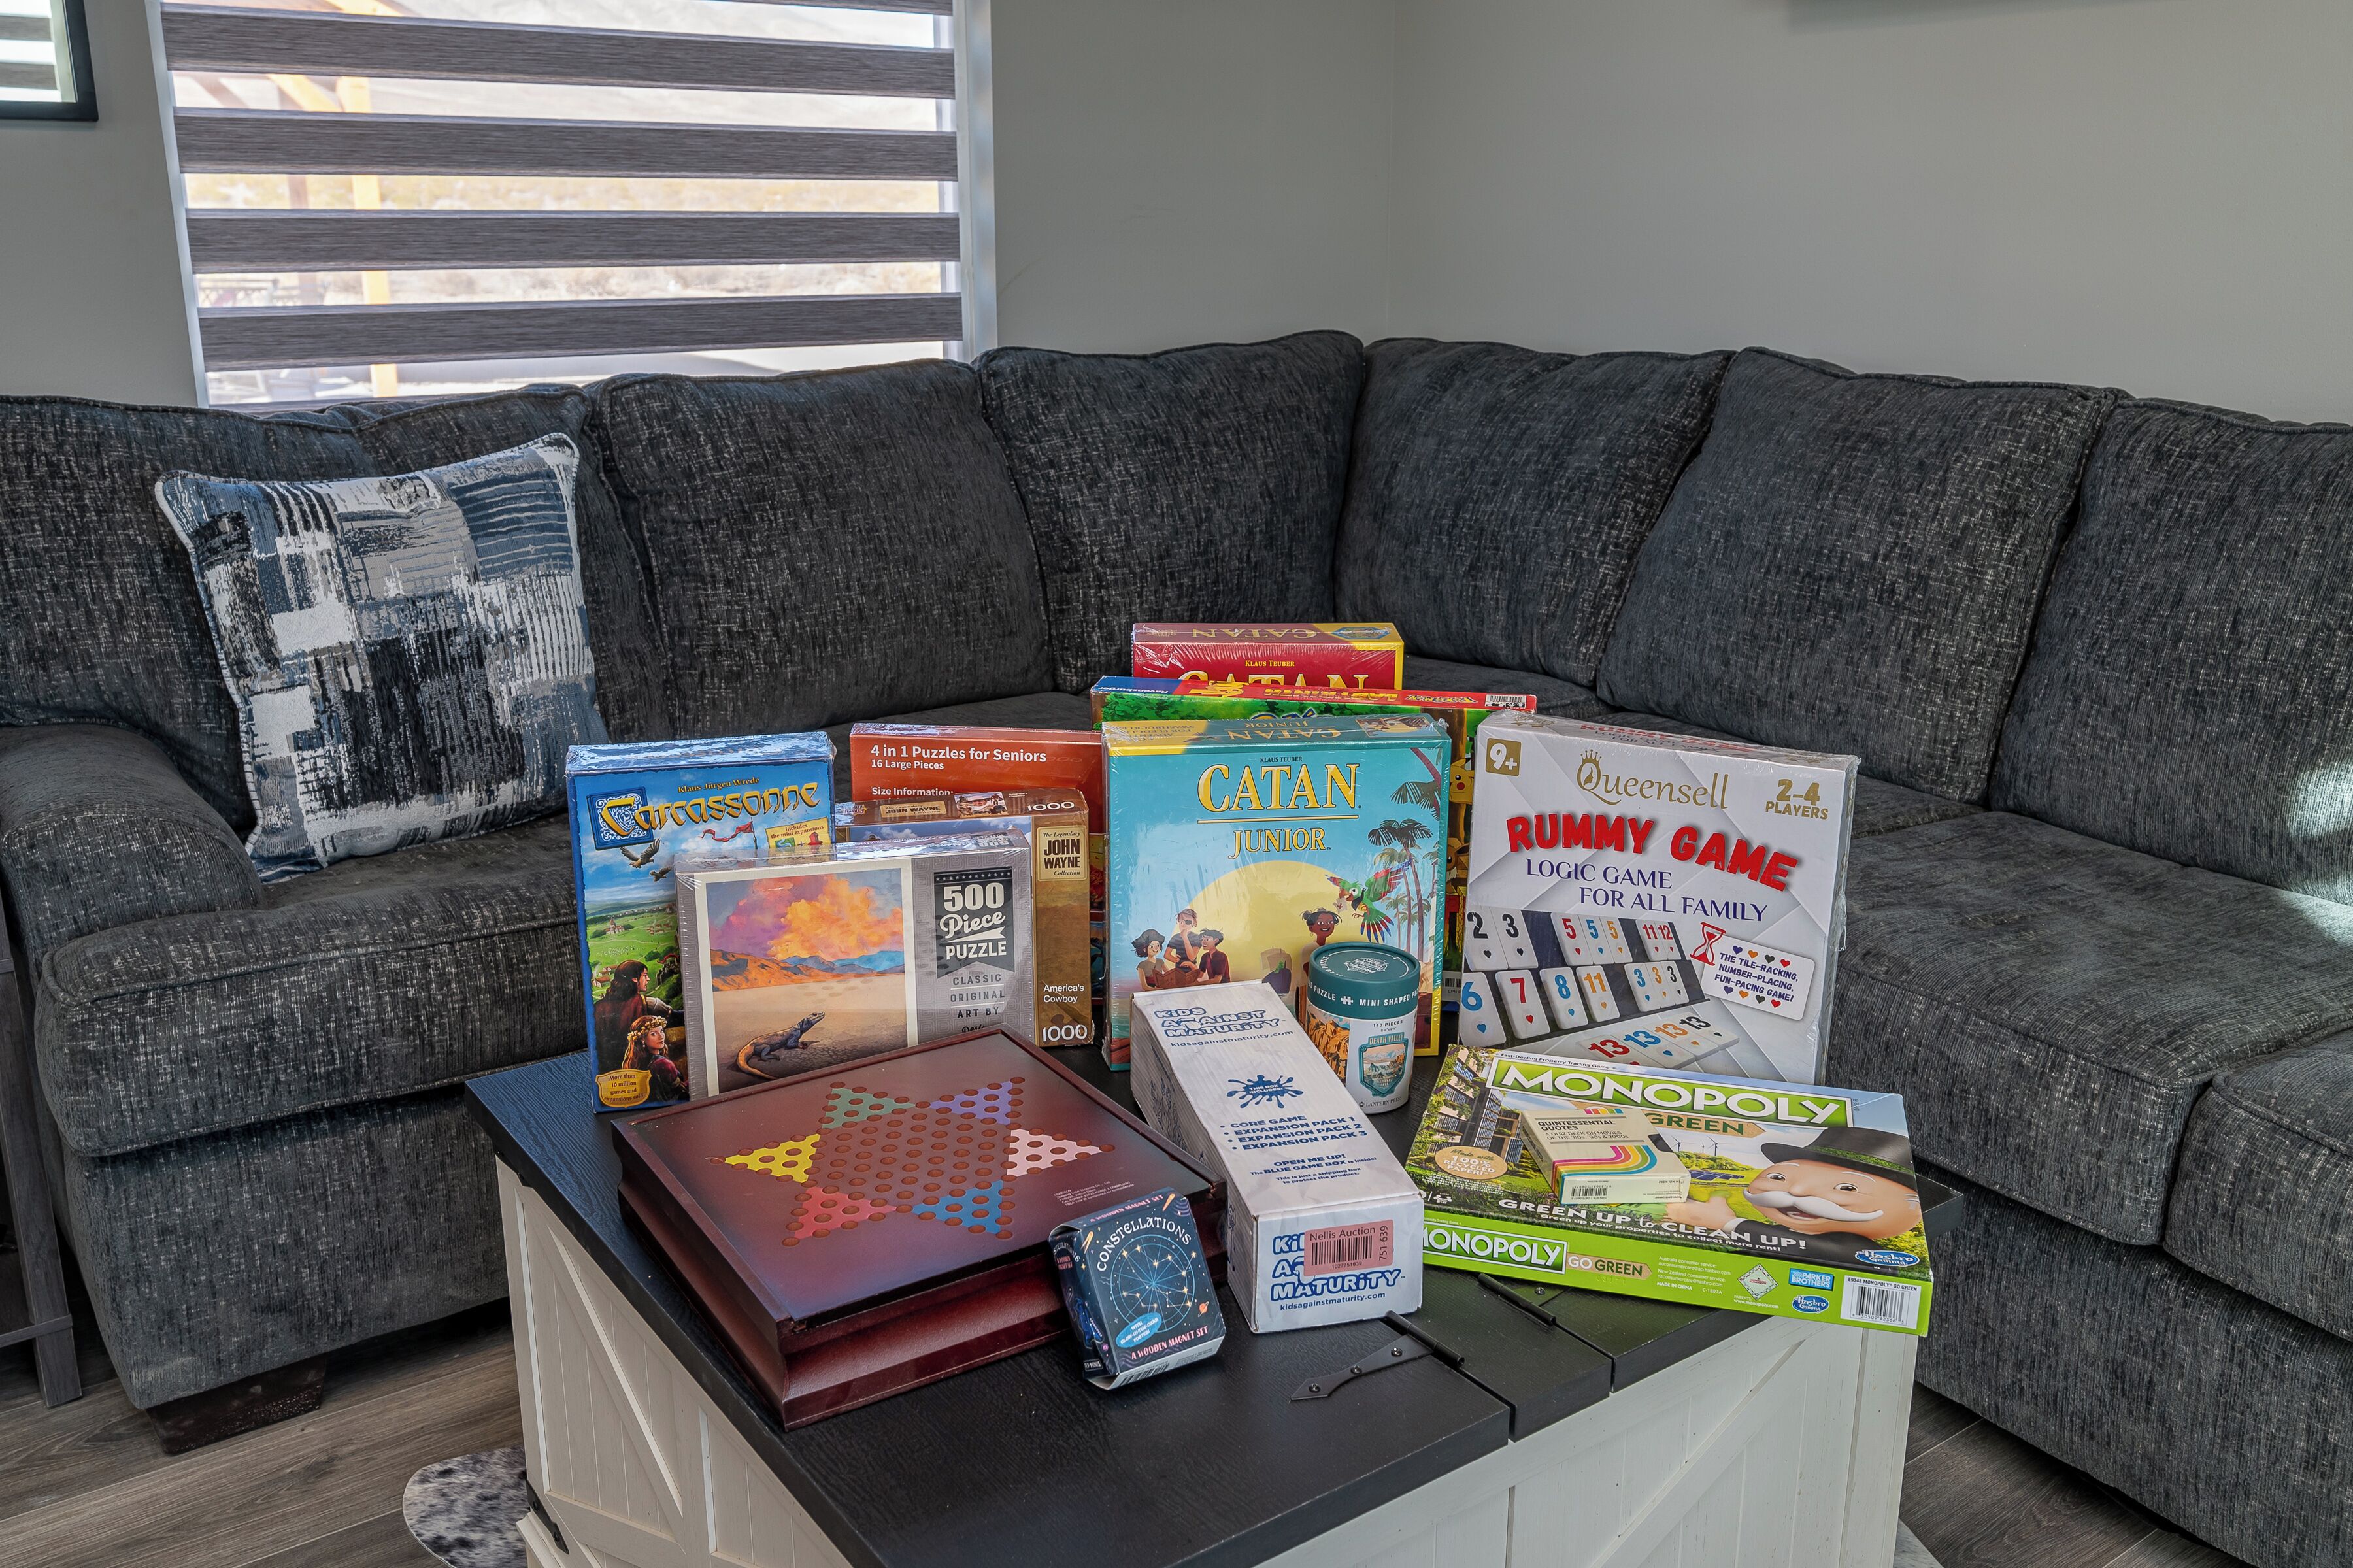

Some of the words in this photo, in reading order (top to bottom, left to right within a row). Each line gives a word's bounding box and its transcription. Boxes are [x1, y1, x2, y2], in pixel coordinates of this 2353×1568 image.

[1264, 688, 1399, 701] LABYRINTH
[1244, 720, 1310, 728] JUNIOR
[1227, 729, 1341, 740] CATAN
[871, 744, 880, 756] 4
[883, 744, 897, 757] in
[901, 747, 908, 758] 1
[912, 746, 966, 759] Puzzles
[969, 746, 990, 760] for
[993, 748, 1046, 763] Seniors
[1490, 743, 1518, 771] 9+
[871, 759, 882, 768] 16
[885, 759, 912, 771] Large
[914, 760, 944, 770] Pieces
[678, 780, 731, 793] Klaus-Jürgen
[733, 777, 759, 786] Wrede
[872, 787, 891, 795] Size
[1197, 763, 1360, 812] CATAN
[1576, 757, 1729, 809] Queensell
[1776, 778, 1820, 804] 2-4
[600, 782, 821, 837] Carcassonne
[1027, 801, 1075, 812] 1000
[1765, 801, 1829, 821] PLAYERS
[794, 825, 824, 835] expansions
[1043, 839, 1080, 856] JOHN
[1228, 827, 1326, 859] JUNIOR
[1506, 812, 1655, 854] RUMMY
[1670, 827, 1799, 892] GAME
[1043, 856, 1080, 869] WAYNE
[1526, 858, 1595, 882] LOGIC
[1603, 866, 1672, 890] GAME
[944, 882, 1005, 912] 500
[1579, 886, 1624, 909] FOR
[1631, 892, 1675, 914] ALL
[1682, 897, 1768, 922] FAMILY
[939, 910, 1006, 939] Piece
[1467, 912, 1488, 939] 2
[1502, 913, 1519, 939] 3
[1561, 918, 1577, 940] 5
[1586, 919, 1599, 939] 5
[1607, 920, 1619, 939] 5
[1642, 924, 1659, 940] 11
[1658, 924, 1673, 940] 12
[945, 941, 1007, 960] PUZZLE
[1720, 952, 1737, 963] THE
[952, 973, 1002, 986] CLASSIC
[1714, 974, 1765, 994] FUN-PACING
[1767, 989, 1794, 1002] GAME!
[950, 990, 1005, 1003] ORIGINAL
[1043, 984, 1084, 993] America's
[1314, 985, 1336, 1001] PUZZLE
[1383, 994, 1410, 1006] SHAPED
[1461, 981, 1483, 1012] 6
[1510, 977, 1527, 1003] 7
[1555, 975, 1571, 999] 8
[1584, 972, 1607, 993] 11
[1634, 969, 1646, 988] 3
[1652, 967, 1662, 984] 3
[1667, 965, 1677, 983] 3
[1043, 994, 1078, 1003] Cowboy
[957, 1009, 979, 1018] ART
[986, 1007, 999, 1016] BY
[1041, 1024, 1088, 1042] 1000
[1171, 1030, 1294, 1047] kidsagainstmaturity.com
[1369, 1037, 1387, 1045] DEATH
[1588, 1039, 1631, 1059] 13
[1623, 1030, 1661, 1048] 13
[1654, 1023, 1688, 1039] 13
[1679, 1016, 1711, 1031] 13
[1501, 1053, 1538, 1062] Fast-Dealing
[1539, 1057, 1567, 1065] Property
[1501, 1065, 1841, 1124] MONOPOLY
[1230, 1120, 1267, 1129] CORE
[1269, 1115, 1307, 1124] GAME
[1233, 1122, 1310, 1136] EXPANSION
[1313, 1117, 1347, 1127] PACK
[1646, 1112, 1744, 1135] GREEN
[1237, 1129, 1315, 1143] EXPANSION
[1317, 1124, 1351, 1135] PACK
[1242, 1137, 1320, 1150] EXPANSION
[1322, 1131, 1357, 1141] PACK
[1273, 1158, 1305, 1167] OPEN
[1443, 1159, 1496, 1173] RECYCLED
[1452, 1156, 1491, 1168] 100%
[1498, 1199, 1586, 1219] GREEN
[1595, 1212, 1631, 1224] UP
[1637, 1214, 1656, 1229] to
[1660, 1221, 1752, 1243] CLEAN
[1760, 1234, 1807, 1250] UP!
[1310, 1231, 1336, 1241] Nellis
[1339, 1227, 1376, 1237] Auction
[1378, 1226, 1388, 1261] 751-639
[1858, 1249, 1914, 1261] Hasbro
[1869, 1256, 1907, 1267] Gaming
[1568, 1256, 1593, 1270] GO
[1594, 1259, 1643, 1278] GREEN
[1792, 1275, 1831, 1288] BROTHERS
[1802, 1272, 1831, 1282] PARKER
[1280, 1292, 1386, 1311] kidsagainstmaturity.com
[1733, 1299, 1779, 1309] www.monopoly.com
[1795, 1296, 1826, 1307] Hasbro
[1799, 1303, 1821, 1313] Gaming
[1130, 1320, 1143, 1331] WITH
[1131, 1352, 1137, 1360] A
[1137, 1341, 1168, 1358] WOODEN
[1168, 1329, 1195, 1348] MAGNET
[1196, 1326, 1209, 1336] SET
